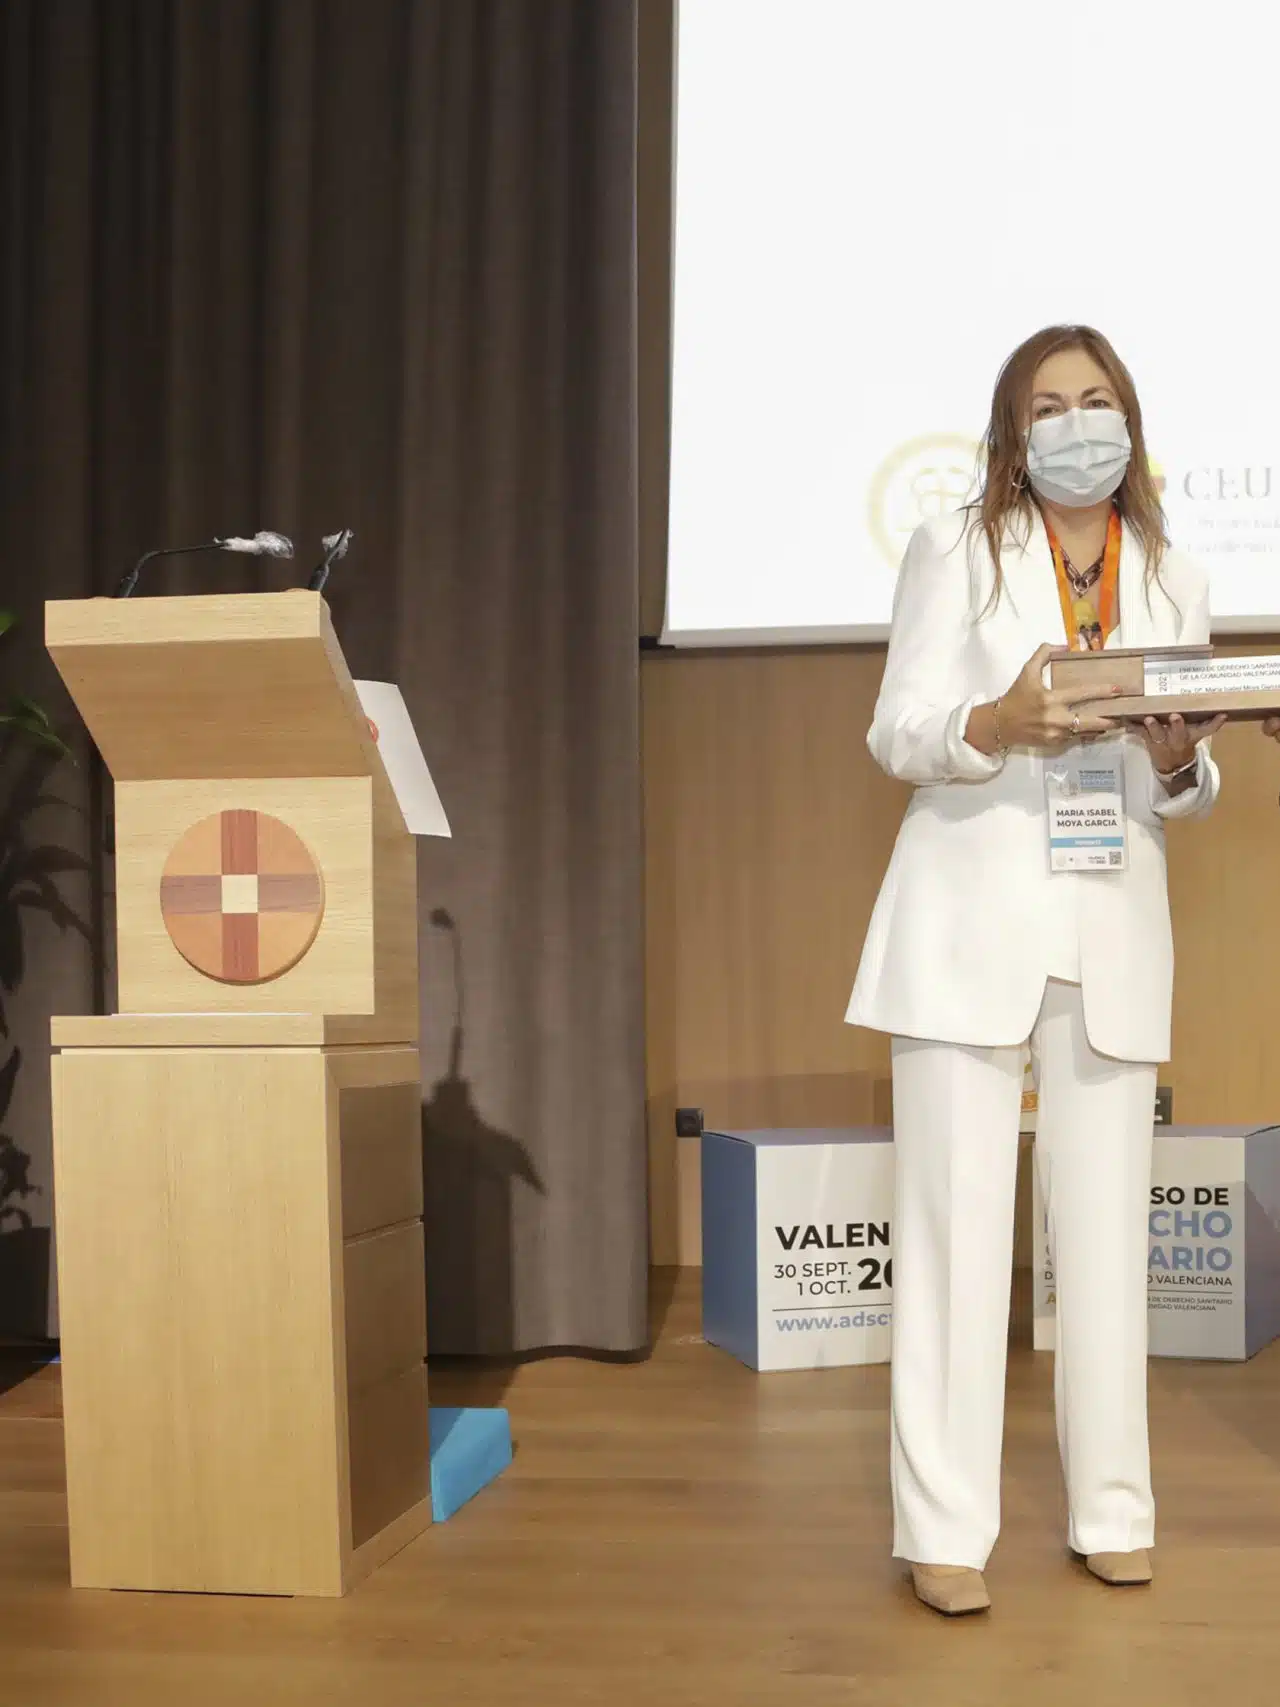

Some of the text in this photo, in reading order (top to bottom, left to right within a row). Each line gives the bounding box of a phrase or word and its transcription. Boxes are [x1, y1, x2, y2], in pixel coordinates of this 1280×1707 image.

[1182, 466, 1272, 501] CEU
[1200, 671, 1242, 680] COMUNIDAD
[1217, 663, 1249, 672] DERECHO
[1056, 808, 1117, 817] MARIA ISABEL
[1057, 819, 1083, 828] MOYA
[1150, 1186, 1229, 1206] SO DE
[1148, 1209, 1233, 1238] CHO
[775, 1222, 890, 1251] VALEN
[1147, 1245, 1233, 1272] ARIO
[773, 1261, 852, 1279] 30 SEPT.
[796, 1280, 851, 1296] 1 OCT.
[1156, 1274, 1233, 1286] VALENCIANA
[1163, 1296, 1196, 1304] DERECHO
[1196, 1297, 1233, 1306] SANITARIO
[1173, 1304, 1217, 1312] VALENCIANA
[775, 1311, 893, 1333] www.adsc
